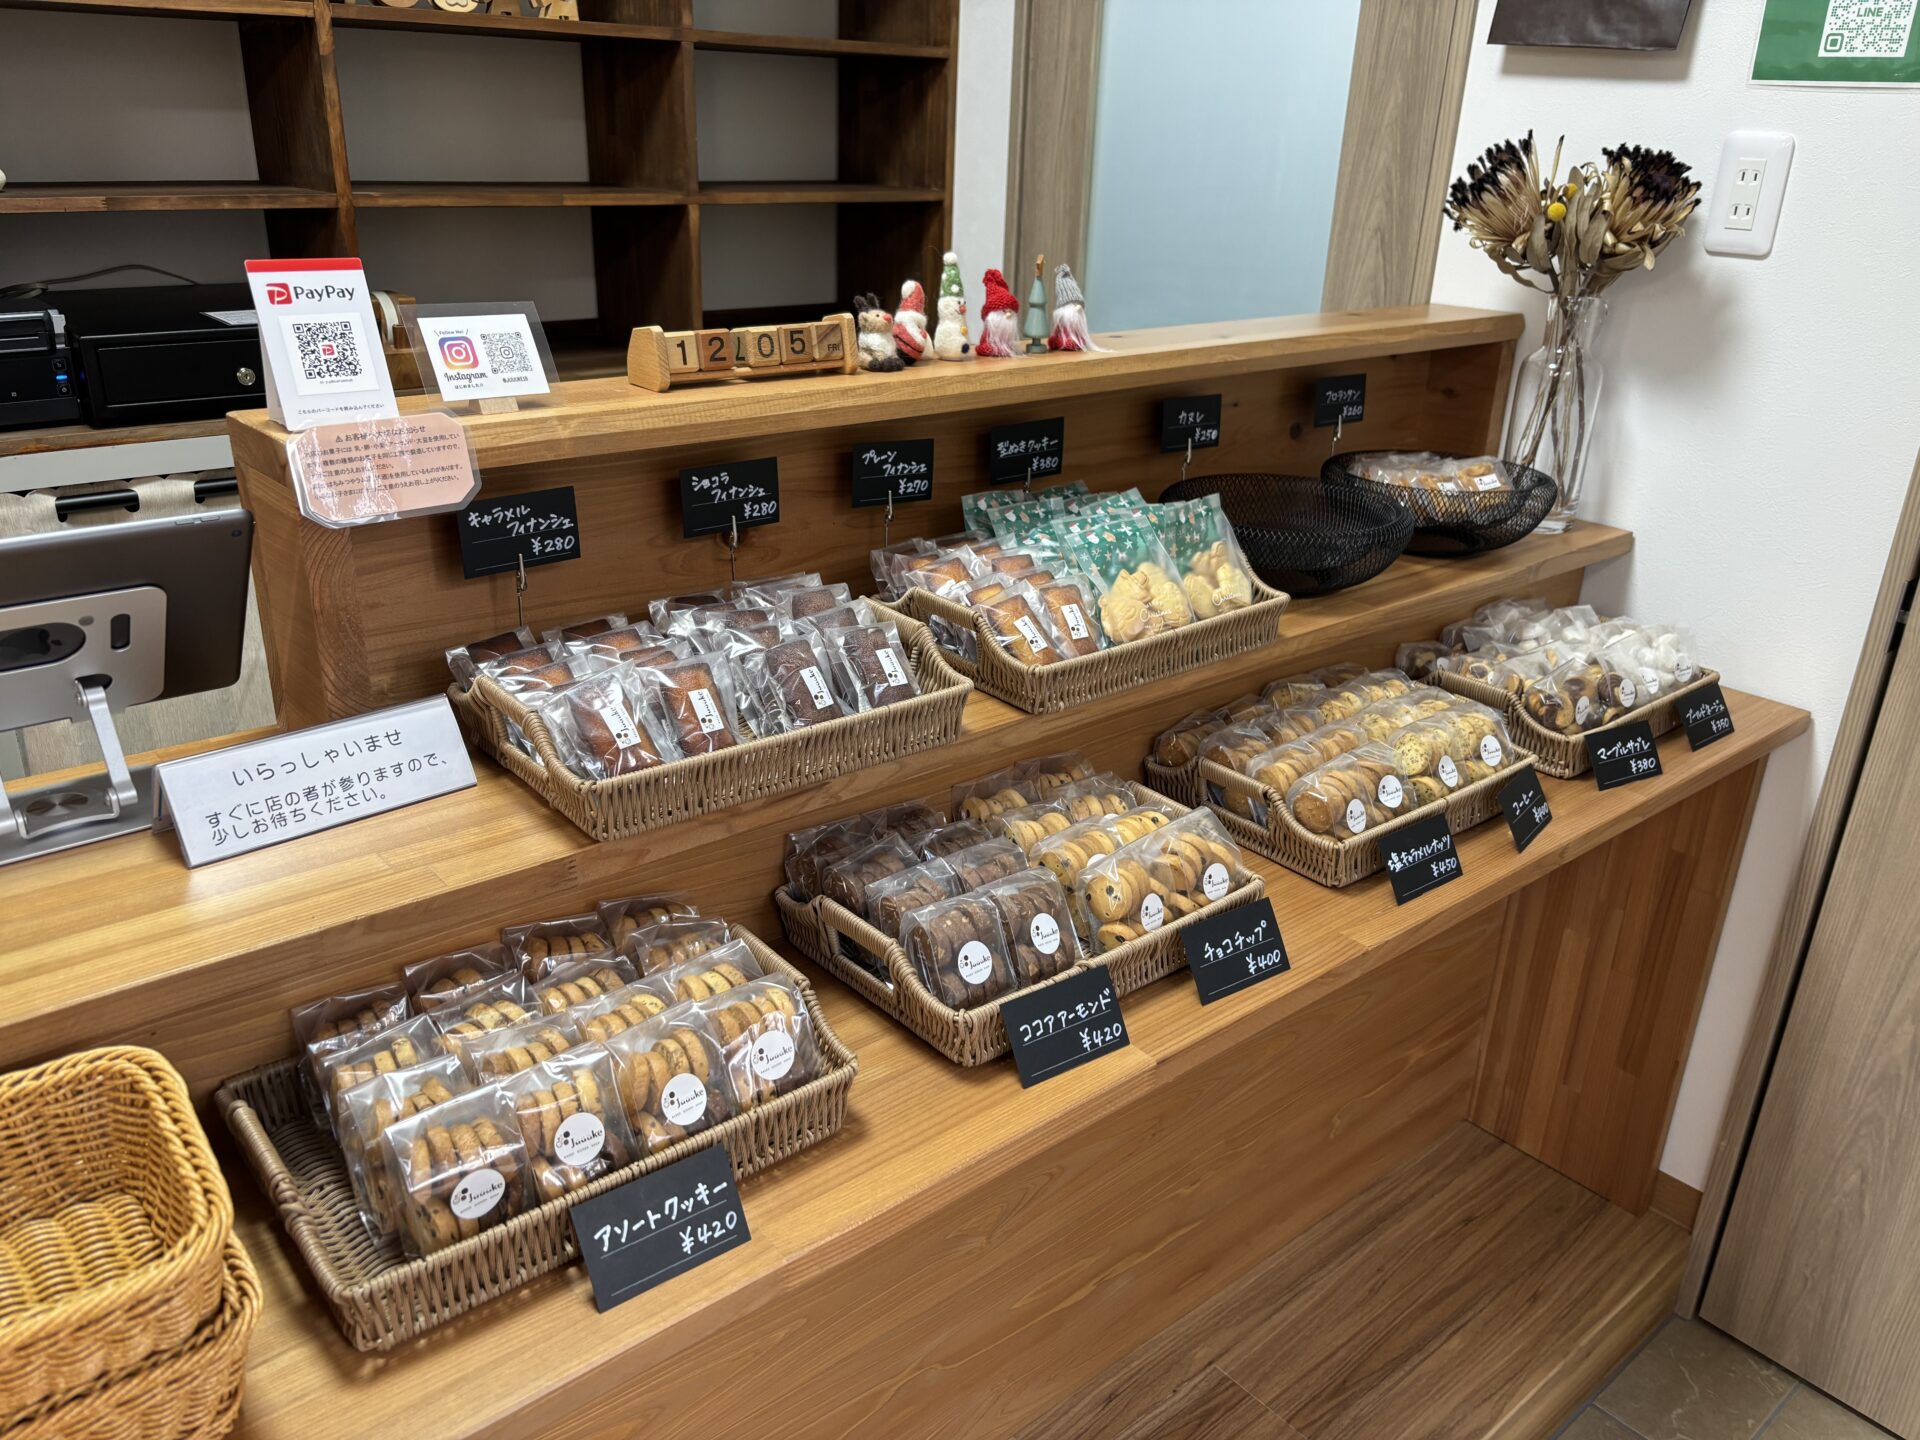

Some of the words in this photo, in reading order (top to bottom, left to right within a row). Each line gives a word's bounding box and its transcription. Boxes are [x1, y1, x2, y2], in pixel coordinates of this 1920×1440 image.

[1856, 7, 1884, 17] LINE
[293, 285, 355, 302] PayPay
[444, 371, 488, 383] Instagram
[1178, 411, 1205, 425] カヌレ
[861, 449, 897, 465] プレーン
[1031, 456, 1060, 472] ¥380
[882, 462, 928, 477] フィナンシェ
[691, 472, 730, 492] ショコラ
[899, 478, 929, 495] ¥270
[711, 484, 766, 504] フィナンシェ
[468, 505, 531, 528] キャラメル
[743, 500, 777, 519] ¥280
[506, 513, 574, 537] フィナンシェ
[531, 535, 575, 556] ¥280
[1711, 717, 1730, 733] ¥350
[231, 729, 404, 787] いらっしゃいませ
[1597, 736, 1651, 760] マーブルサブレ
[1630, 757, 1657, 774] ¥380
[204, 752, 449, 830] すぐに店の者が参りますので、
[1512, 790, 1534, 816] コーヒー
[211, 786, 388, 847] 少しお待ちください。
[1387, 834, 1450, 873] 塩キャラメルナッツ
[1430, 857, 1457, 878] ¥450
[1204, 919, 1267, 962] チョコチップ
[1245, 949, 1281, 975] ¥400
[1019, 987, 1111, 1042] ココアアーモンド
[1079, 1022, 1122, 1052] ¥420
[594, 1182, 728, 1252] アソートクッキー
[679, 1211, 737, 1255] ¥420
